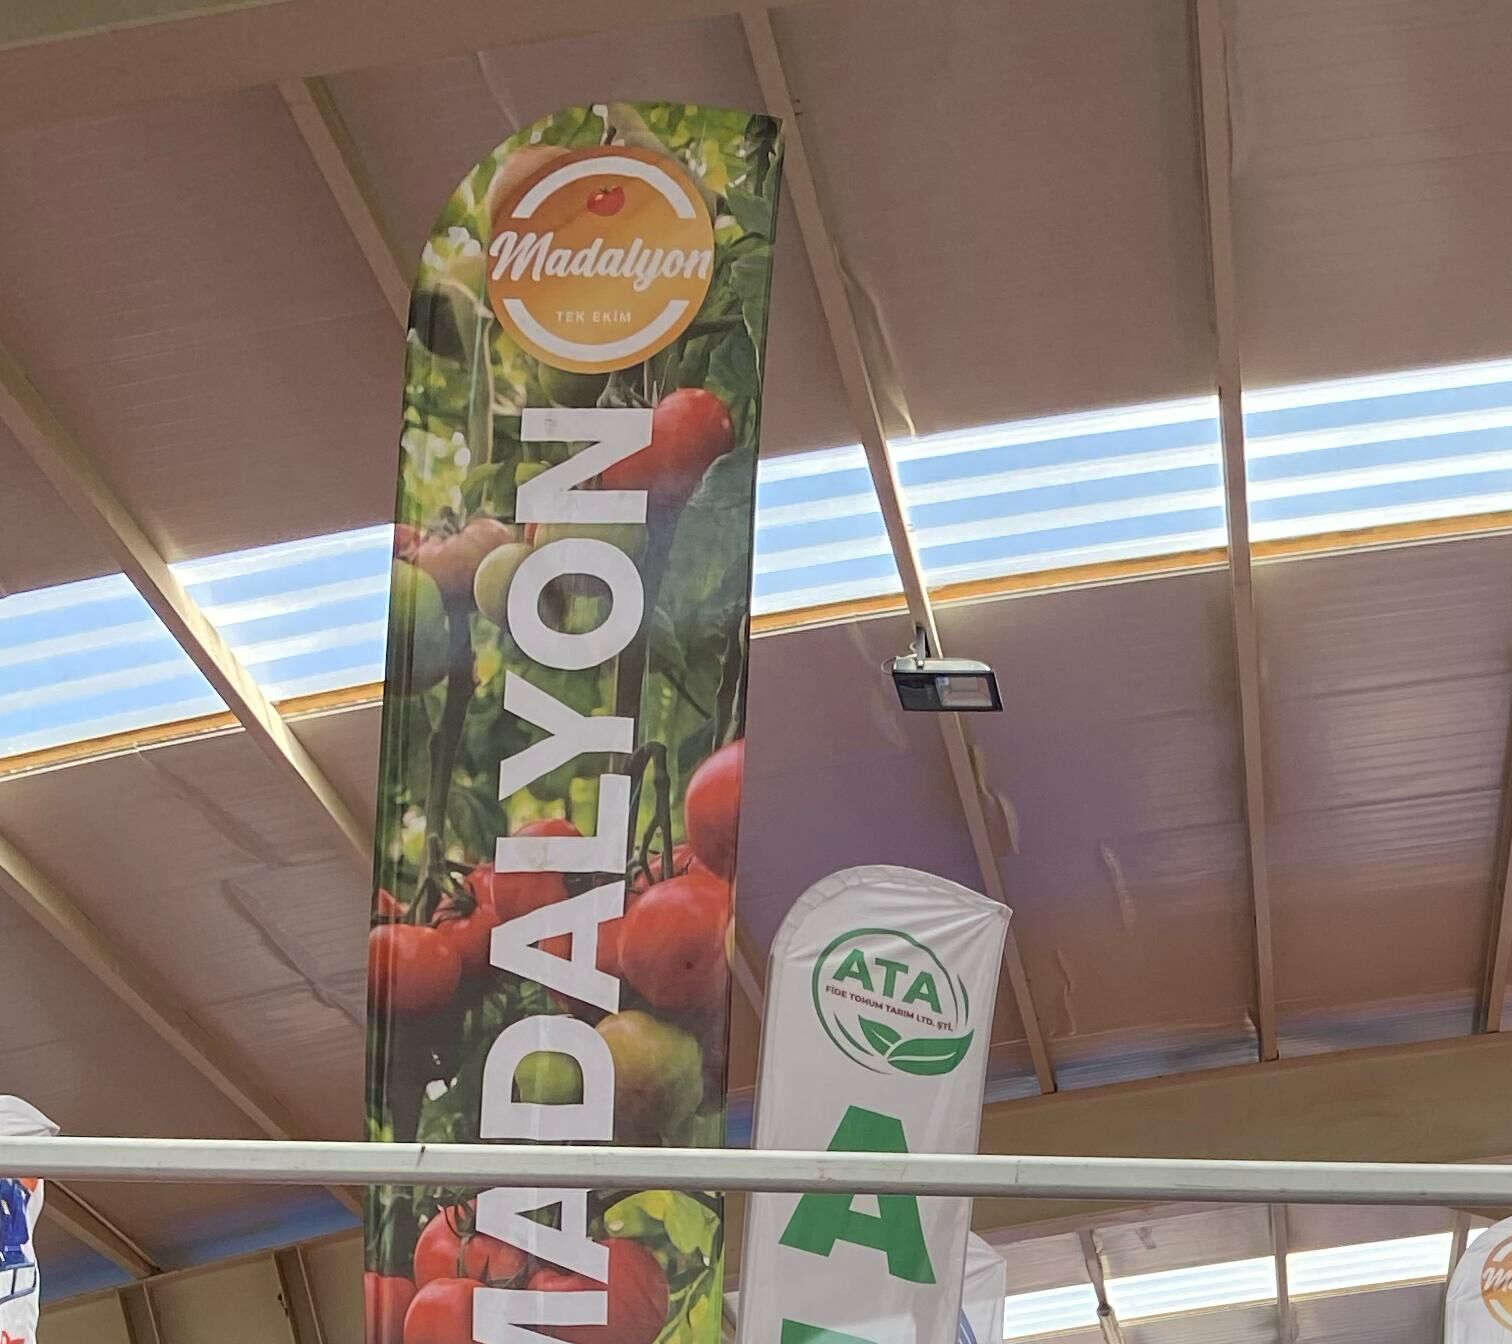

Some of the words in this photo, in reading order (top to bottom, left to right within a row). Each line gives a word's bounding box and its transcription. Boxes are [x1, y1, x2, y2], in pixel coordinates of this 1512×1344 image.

[489, 230, 713, 291] Madalyon
[555, 310, 585, 323] TEK
[590, 308, 632, 323] EKİM
[825, 984, 848, 999] FİDE
[850, 993, 883, 1010] TOHUM
[886, 1004, 914, 1020] TARIM
[832, 948, 943, 1015] ATA
